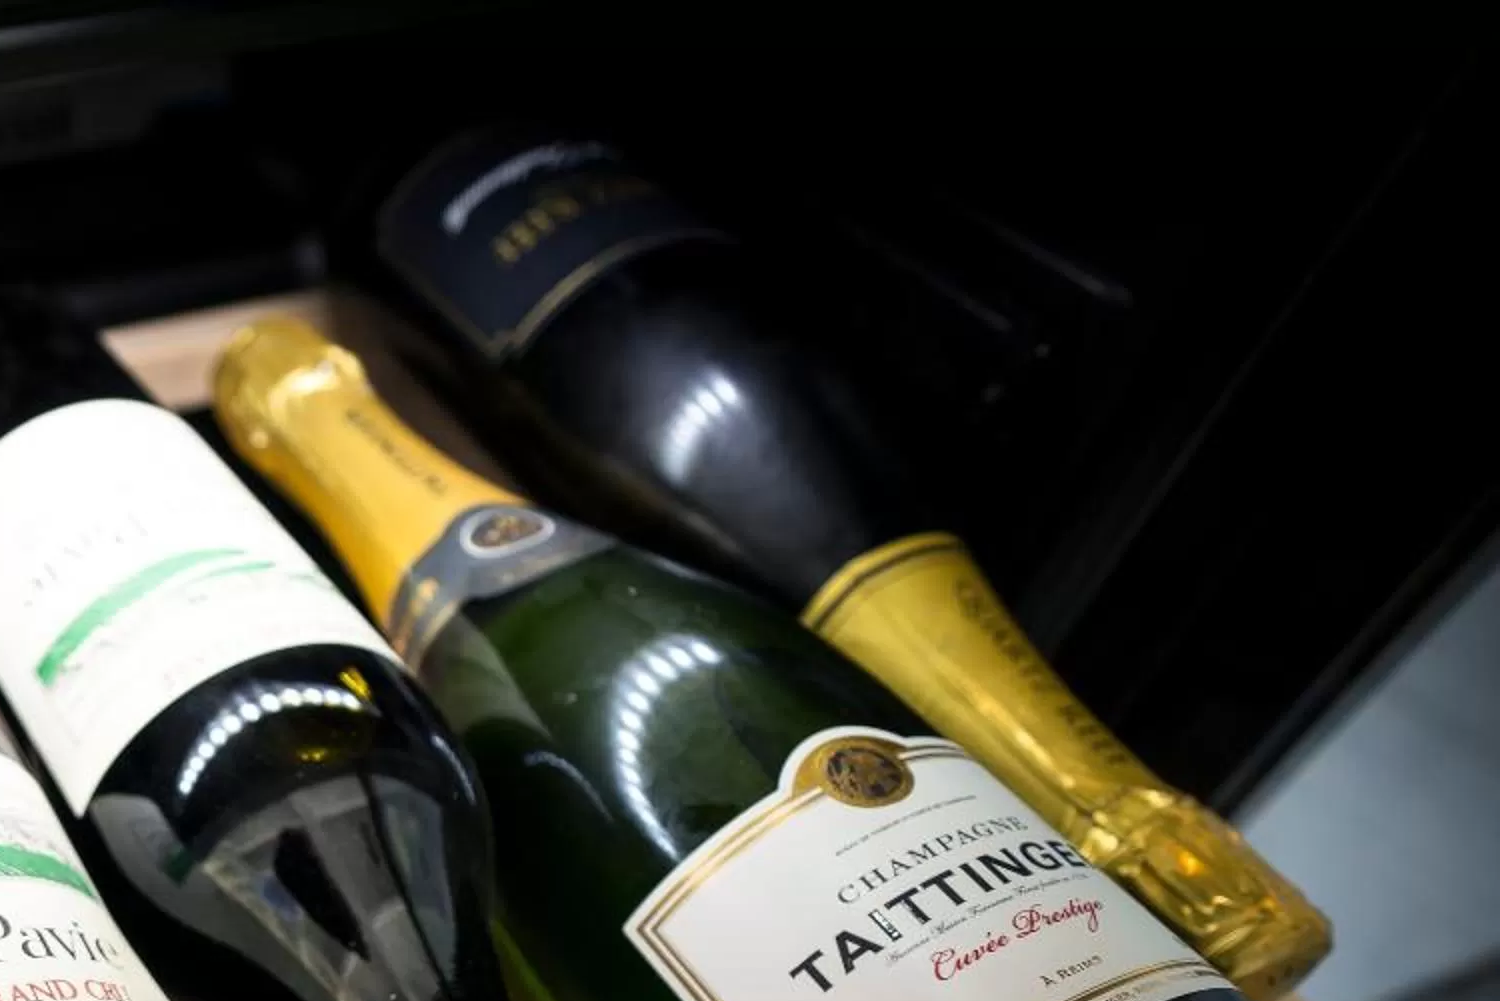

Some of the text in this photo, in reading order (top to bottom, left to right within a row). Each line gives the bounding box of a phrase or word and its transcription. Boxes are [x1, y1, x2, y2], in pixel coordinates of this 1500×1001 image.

[837, 815, 1029, 905] CHAMPAGNE
[788, 840, 1088, 995] TAITTINGE
[930, 932, 1010, 981] Cuvée
[1012, 898, 1103, 939] Prestige
